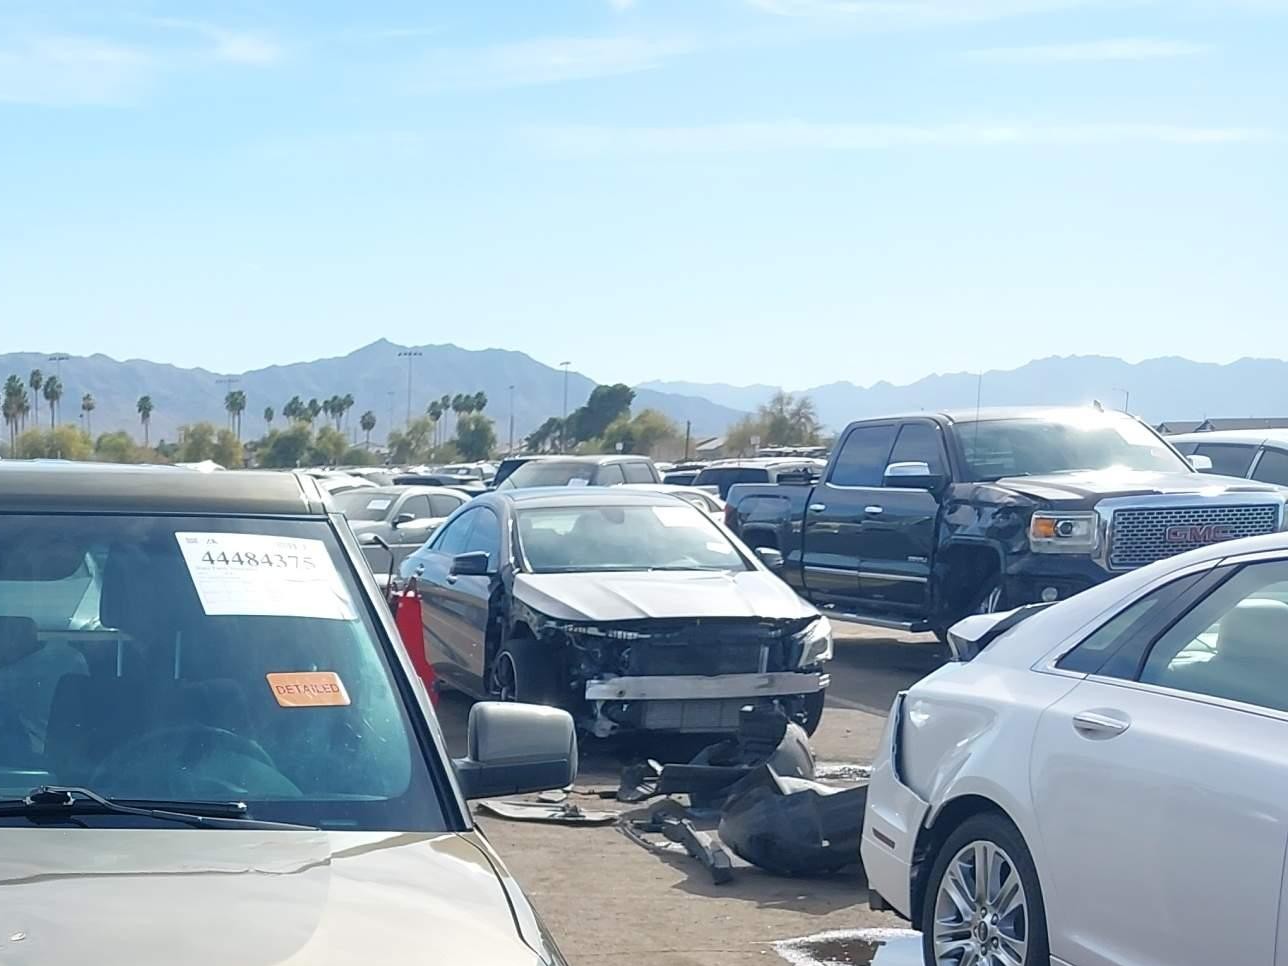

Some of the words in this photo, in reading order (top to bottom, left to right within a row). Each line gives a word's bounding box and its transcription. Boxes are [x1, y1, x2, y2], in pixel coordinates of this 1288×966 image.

[1166, 525, 1234, 543] GMC
[201, 550, 317, 570] 44484375
[276, 683, 340, 695] DETAILED
